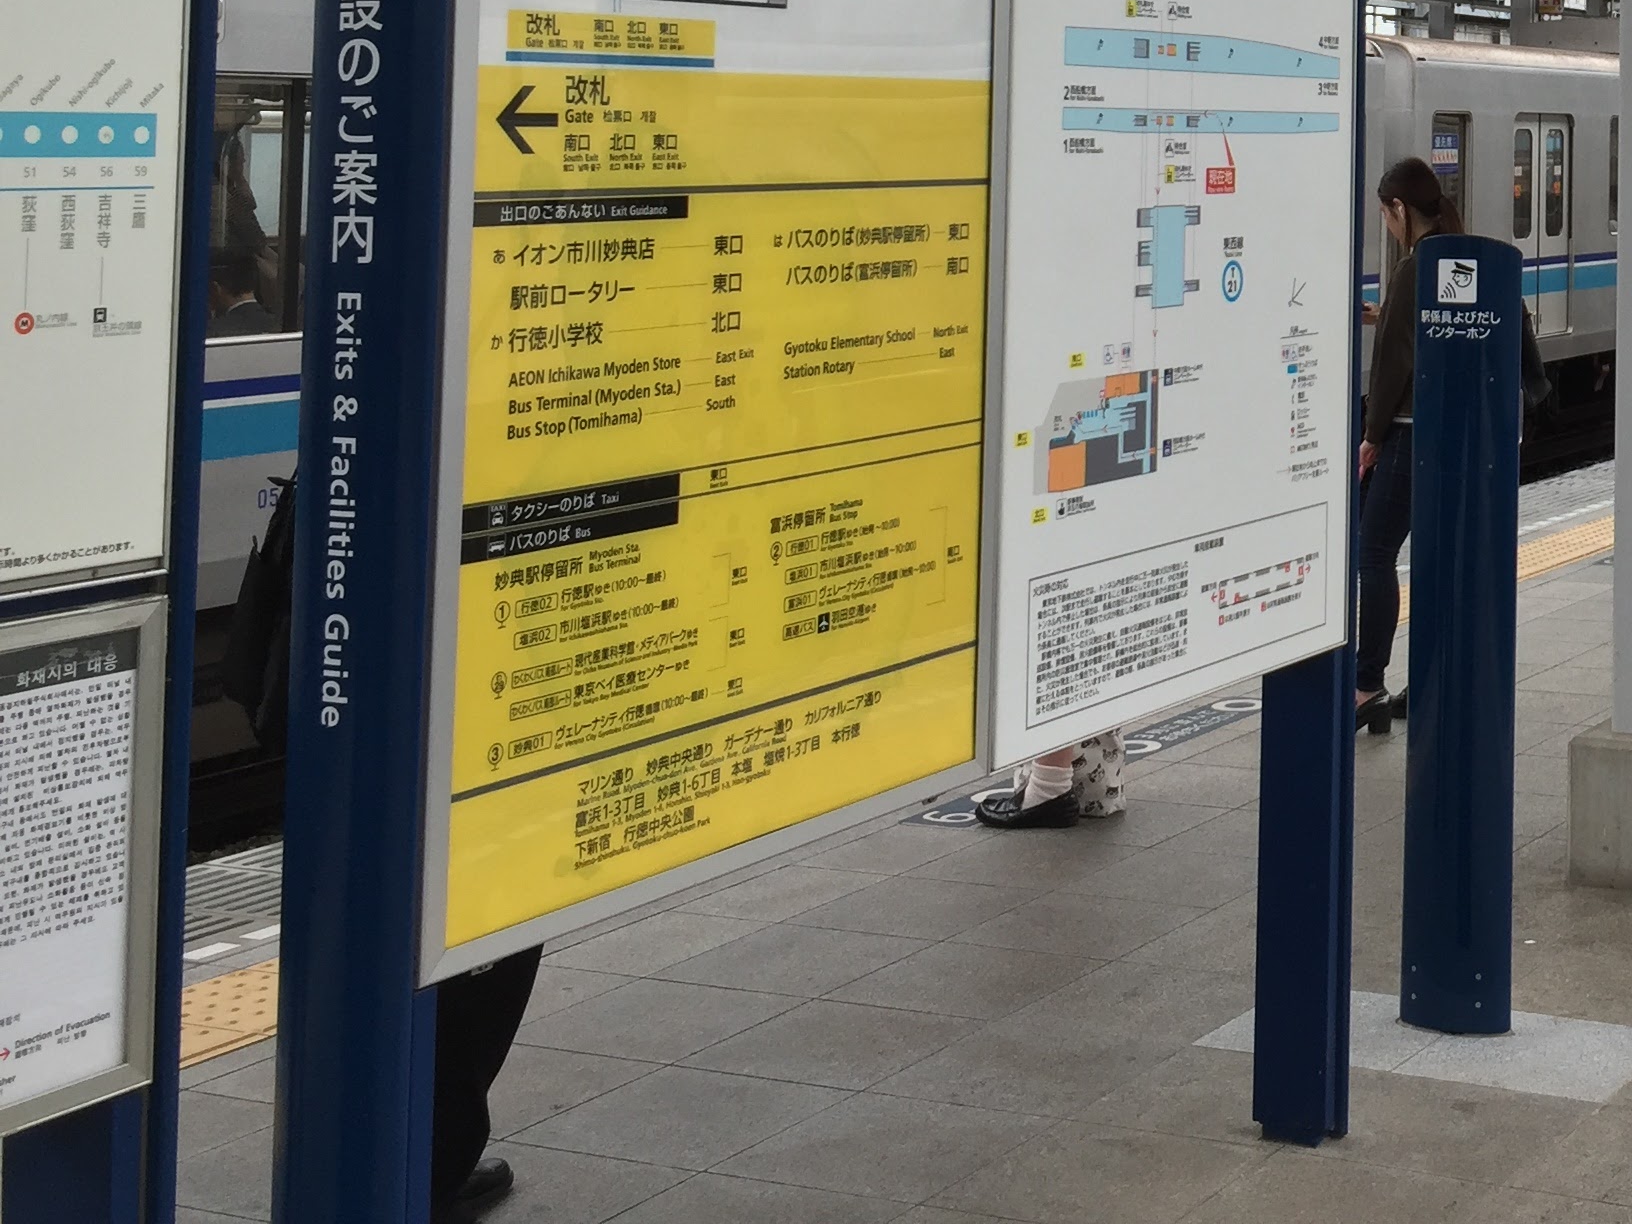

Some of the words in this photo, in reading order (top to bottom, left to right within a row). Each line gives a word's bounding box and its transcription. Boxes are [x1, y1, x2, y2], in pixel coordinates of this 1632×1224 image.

[526, 13, 560, 36] 改札
[627, 21, 646, 34] 北口
[526, 37, 543, 49] Gate
[30, 74, 61, 107] Ogikubo
[565, 75, 610, 106] 改札
[1063, 85, 1070, 100] 2
[565, 109, 594, 124] Gate
[564, 134, 590, 152] 南口
[610, 134, 636, 151] 北口
[652, 134, 678, 151] 東口
[1063, 139, 1068, 153] 1
[563, 153, 583, 163] South
[585, 153, 599, 162] Exit
[609, 153, 629, 162] North
[630, 153, 643, 162] Exit
[652, 153, 666, 162] East
[667, 153, 679, 162] Exit
[23, 166, 37, 178] 51
[62, 166, 76, 178] 54
[100, 166, 114, 177] 56
[134, 165, 148, 177] 59
[500, 203, 607, 222] 出口のごあんない
[611, 205, 627, 216] Exit
[629, 204, 668, 216] Guidance
[948, 223, 970, 241] 東口
[493, 249, 506, 265] あ
[513, 237, 655, 267] イオン市川妙典店
[713, 235, 744, 256] 東口
[946, 256, 970, 276] 南口
[510, 280, 635, 311] 駅前ロータリー
[711, 273, 742, 294] 東口
[1228, 280, 1237, 293] 21
[333, 292, 362, 380] Exits
[491, 335, 504, 351] か
[508, 322, 603, 353] 行徳小学校
[711, 311, 741, 334] 北口
[933, 326, 955, 338] North
[1426, 326, 1491, 339] インターホン
[784, 339, 828, 357] Gyotoku
[830, 332, 884, 350] Elementary
[886, 327, 915, 343] School
[715, 351, 737, 364] East
[739, 348, 754, 360] Exit
[939, 348, 955, 358] East
[508, 370, 545, 388] AEON
[548, 364, 600, 384] Ichikawa
[603, 357, 649, 380] Myoden
[652, 355, 681, 371] Store
[783, 362, 821, 380] Station
[822, 360, 855, 374] Rotary
[715, 374, 736, 387] East
[508, 399, 532, 415] Bus
[536, 390, 592, 411] Terminal
[595, 383, 650, 406] (Myoden
[654, 378, 682, 397] Sta.)
[706, 395, 736, 412] South
[332, 397, 358, 420] &
[507, 424, 531, 440] Bus
[535, 419, 566, 438] Stop
[568, 407, 643, 434] (Tomihama)
[710, 468, 728, 482] 東口
[511, 492, 596, 522] タクシーのりば
[601, 492, 620, 506] Taxi
[325, 437, 356, 599] Facilities
[770, 507, 826, 534] 富浜停留所
[509, 525, 571, 551] バスのりば
[575, 527, 591, 539] Bus
[589, 547, 624, 562] Myoden
[589, 563, 604, 574] Bus
[607, 553, 641, 569] Terminal
[494, 556, 583, 592] 妙典駅停留所
[521, 596, 553, 614] 行徳02
[16, 661, 77, 688] 화재시의
[87, 653, 119, 673] 대응
[320, 613, 350, 727] Guide
[579, 767, 634, 795] マリン通り
[646, 742, 713, 776] 妙典中央通り
[724, 717, 793, 751] ガーデナー通り
[804, 690, 882, 725] カリフォルニア通り
[575, 795, 645, 828] 富浜1-3丁目
[657, 767, 721, 802] 妙典1-6丁目
[575, 834, 611, 859] 下新宿
[623, 805, 695, 842] 行徳中央公園
